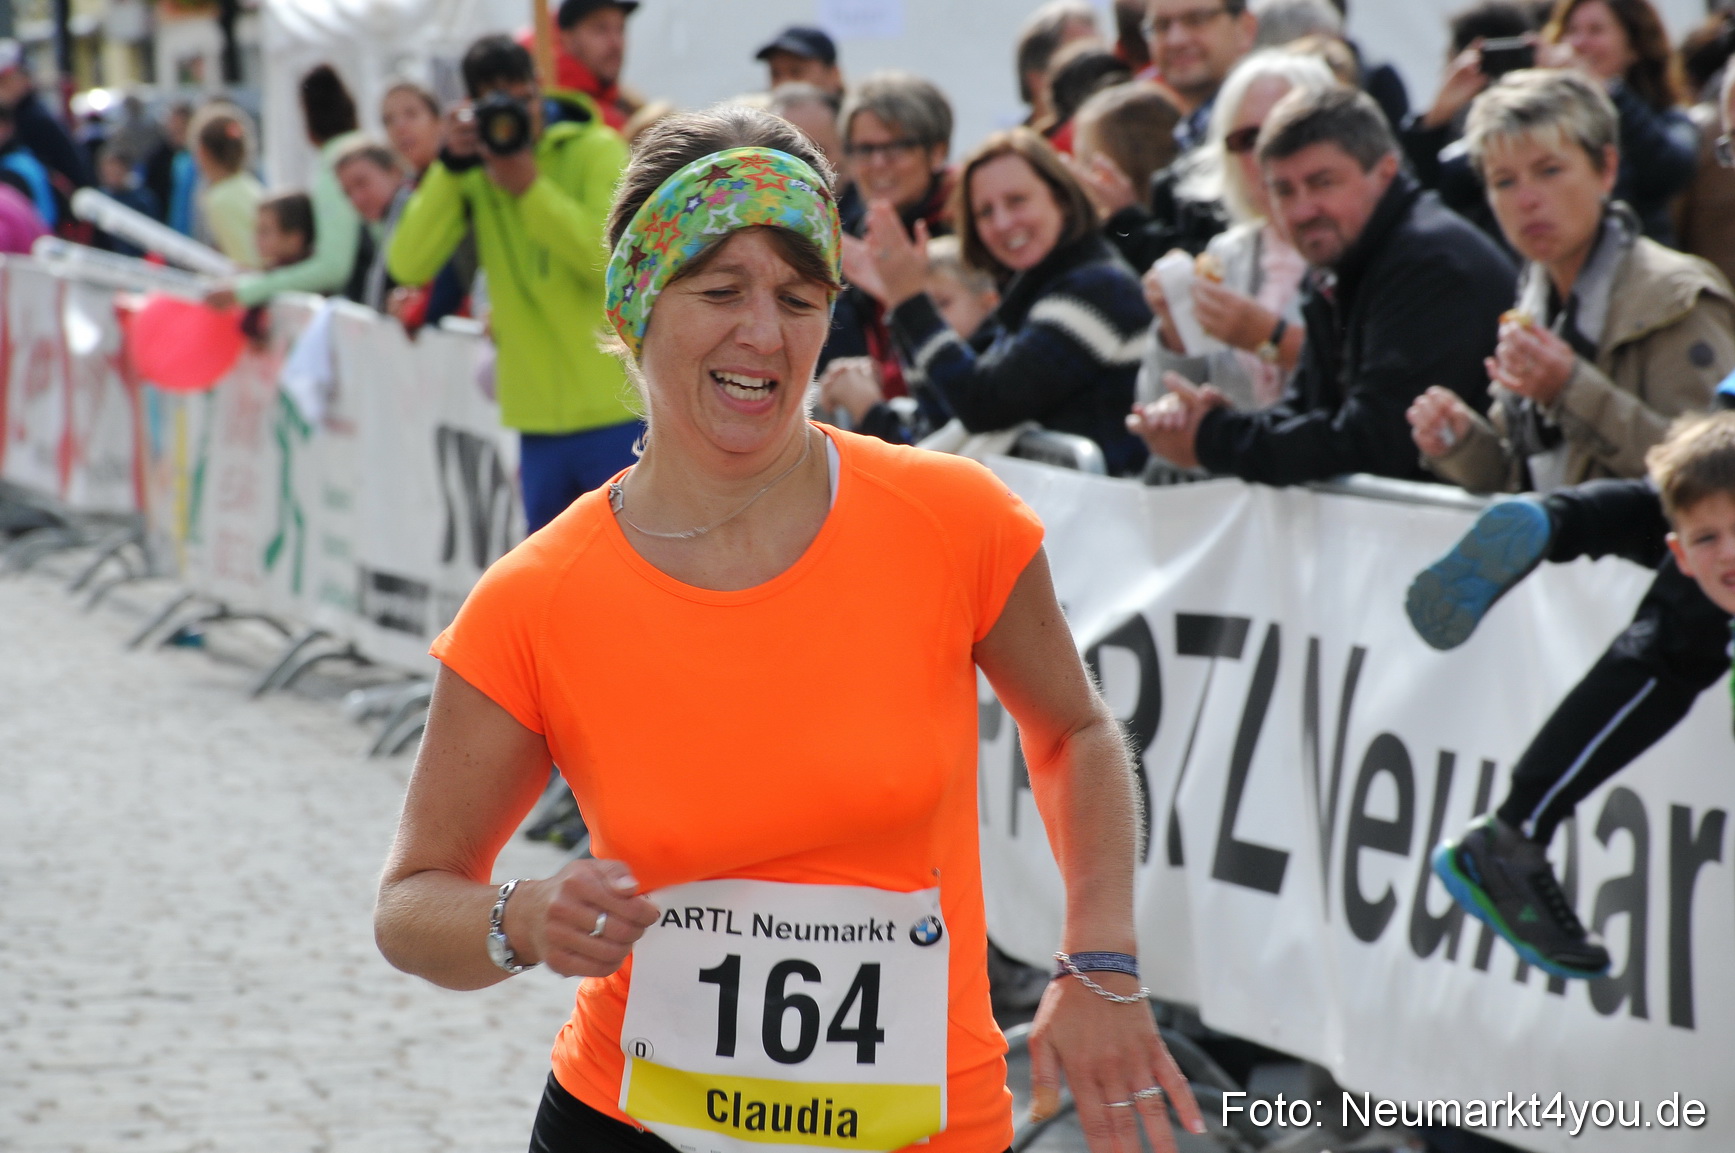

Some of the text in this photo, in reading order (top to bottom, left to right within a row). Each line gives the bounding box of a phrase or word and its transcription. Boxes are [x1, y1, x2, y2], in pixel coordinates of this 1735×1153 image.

[978, 611, 1290, 895] RTL
[657, 906, 743, 936] ARTL
[752, 912, 897, 944] Neumarkt
[698, 953, 885, 1065] 164
[706, 1088, 859, 1139] Claudia
